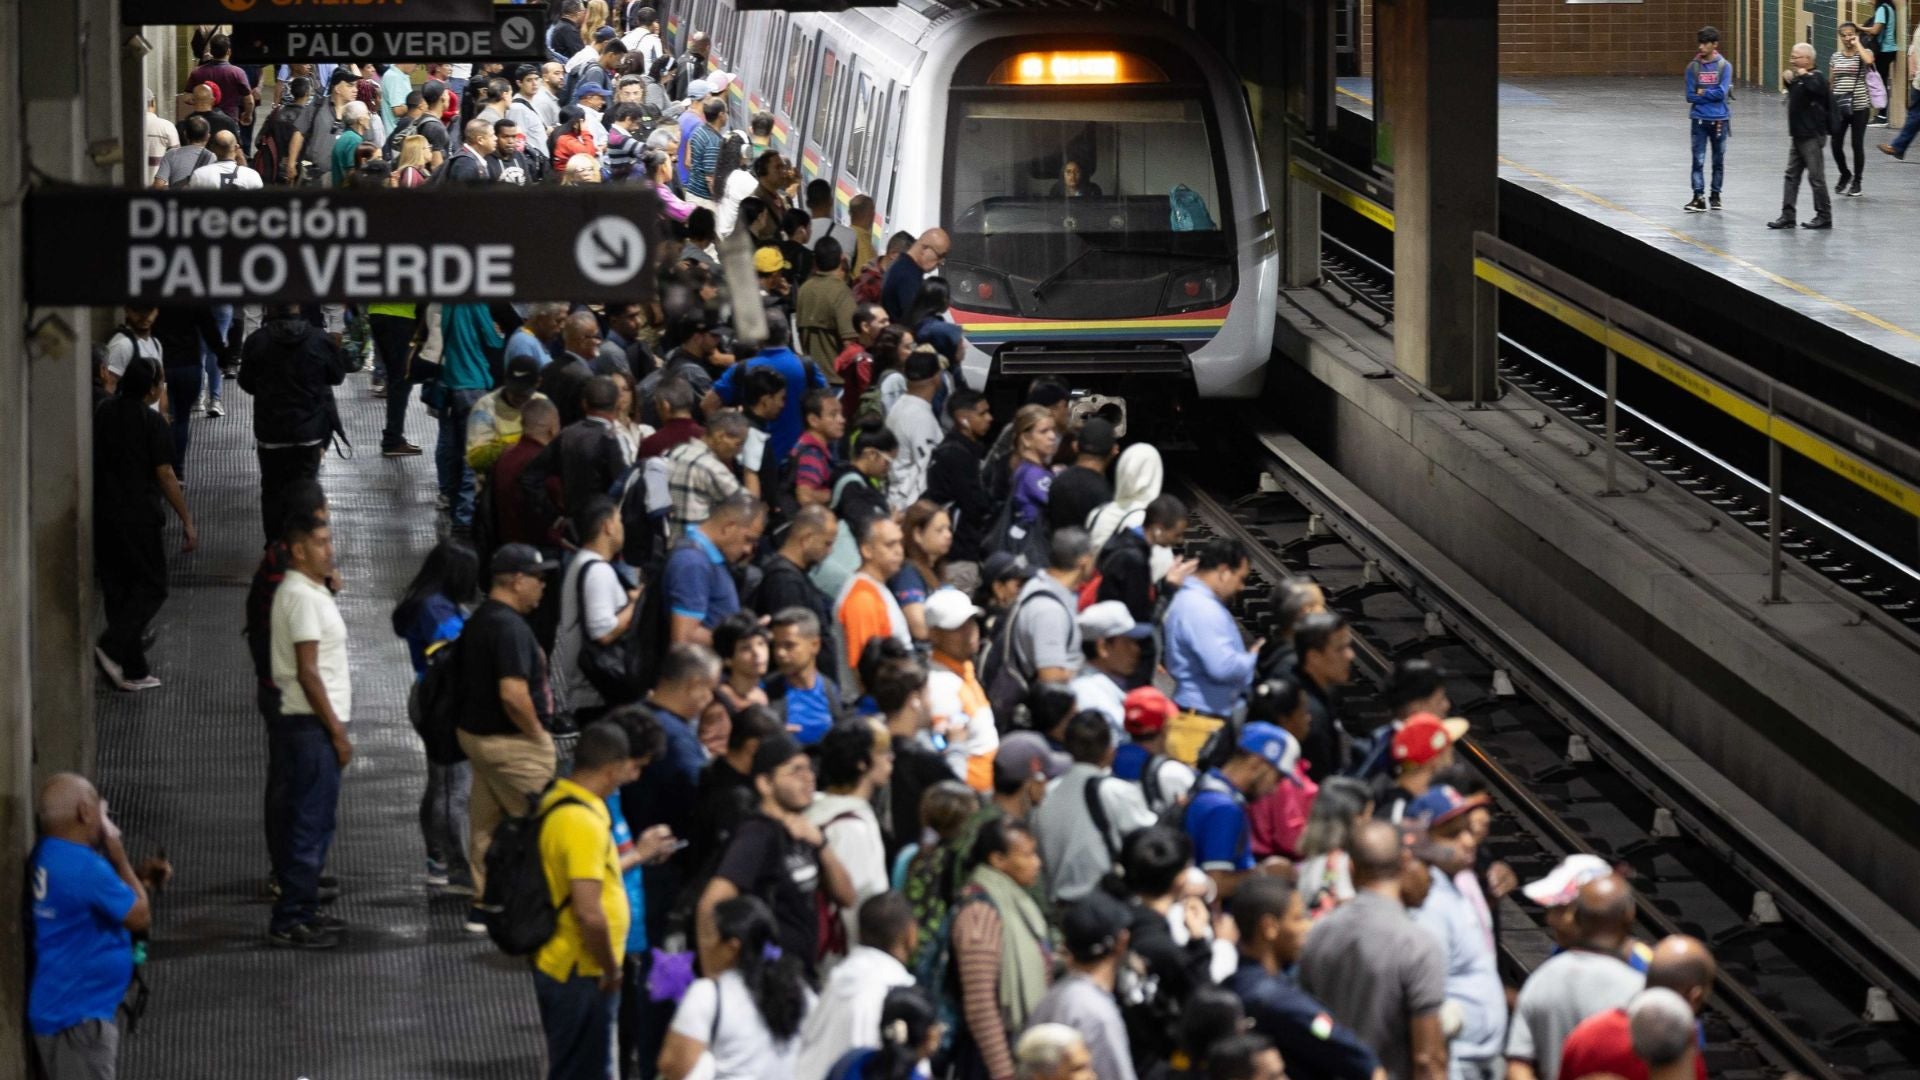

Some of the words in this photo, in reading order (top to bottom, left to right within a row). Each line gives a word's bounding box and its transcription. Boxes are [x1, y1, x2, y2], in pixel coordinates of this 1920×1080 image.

[288, 31, 374, 57] PALO
[384, 31, 491, 56] VERDE
[129, 199, 367, 238] Dirección
[129, 244, 288, 296] PALO
[300, 245, 515, 296] VERDE
